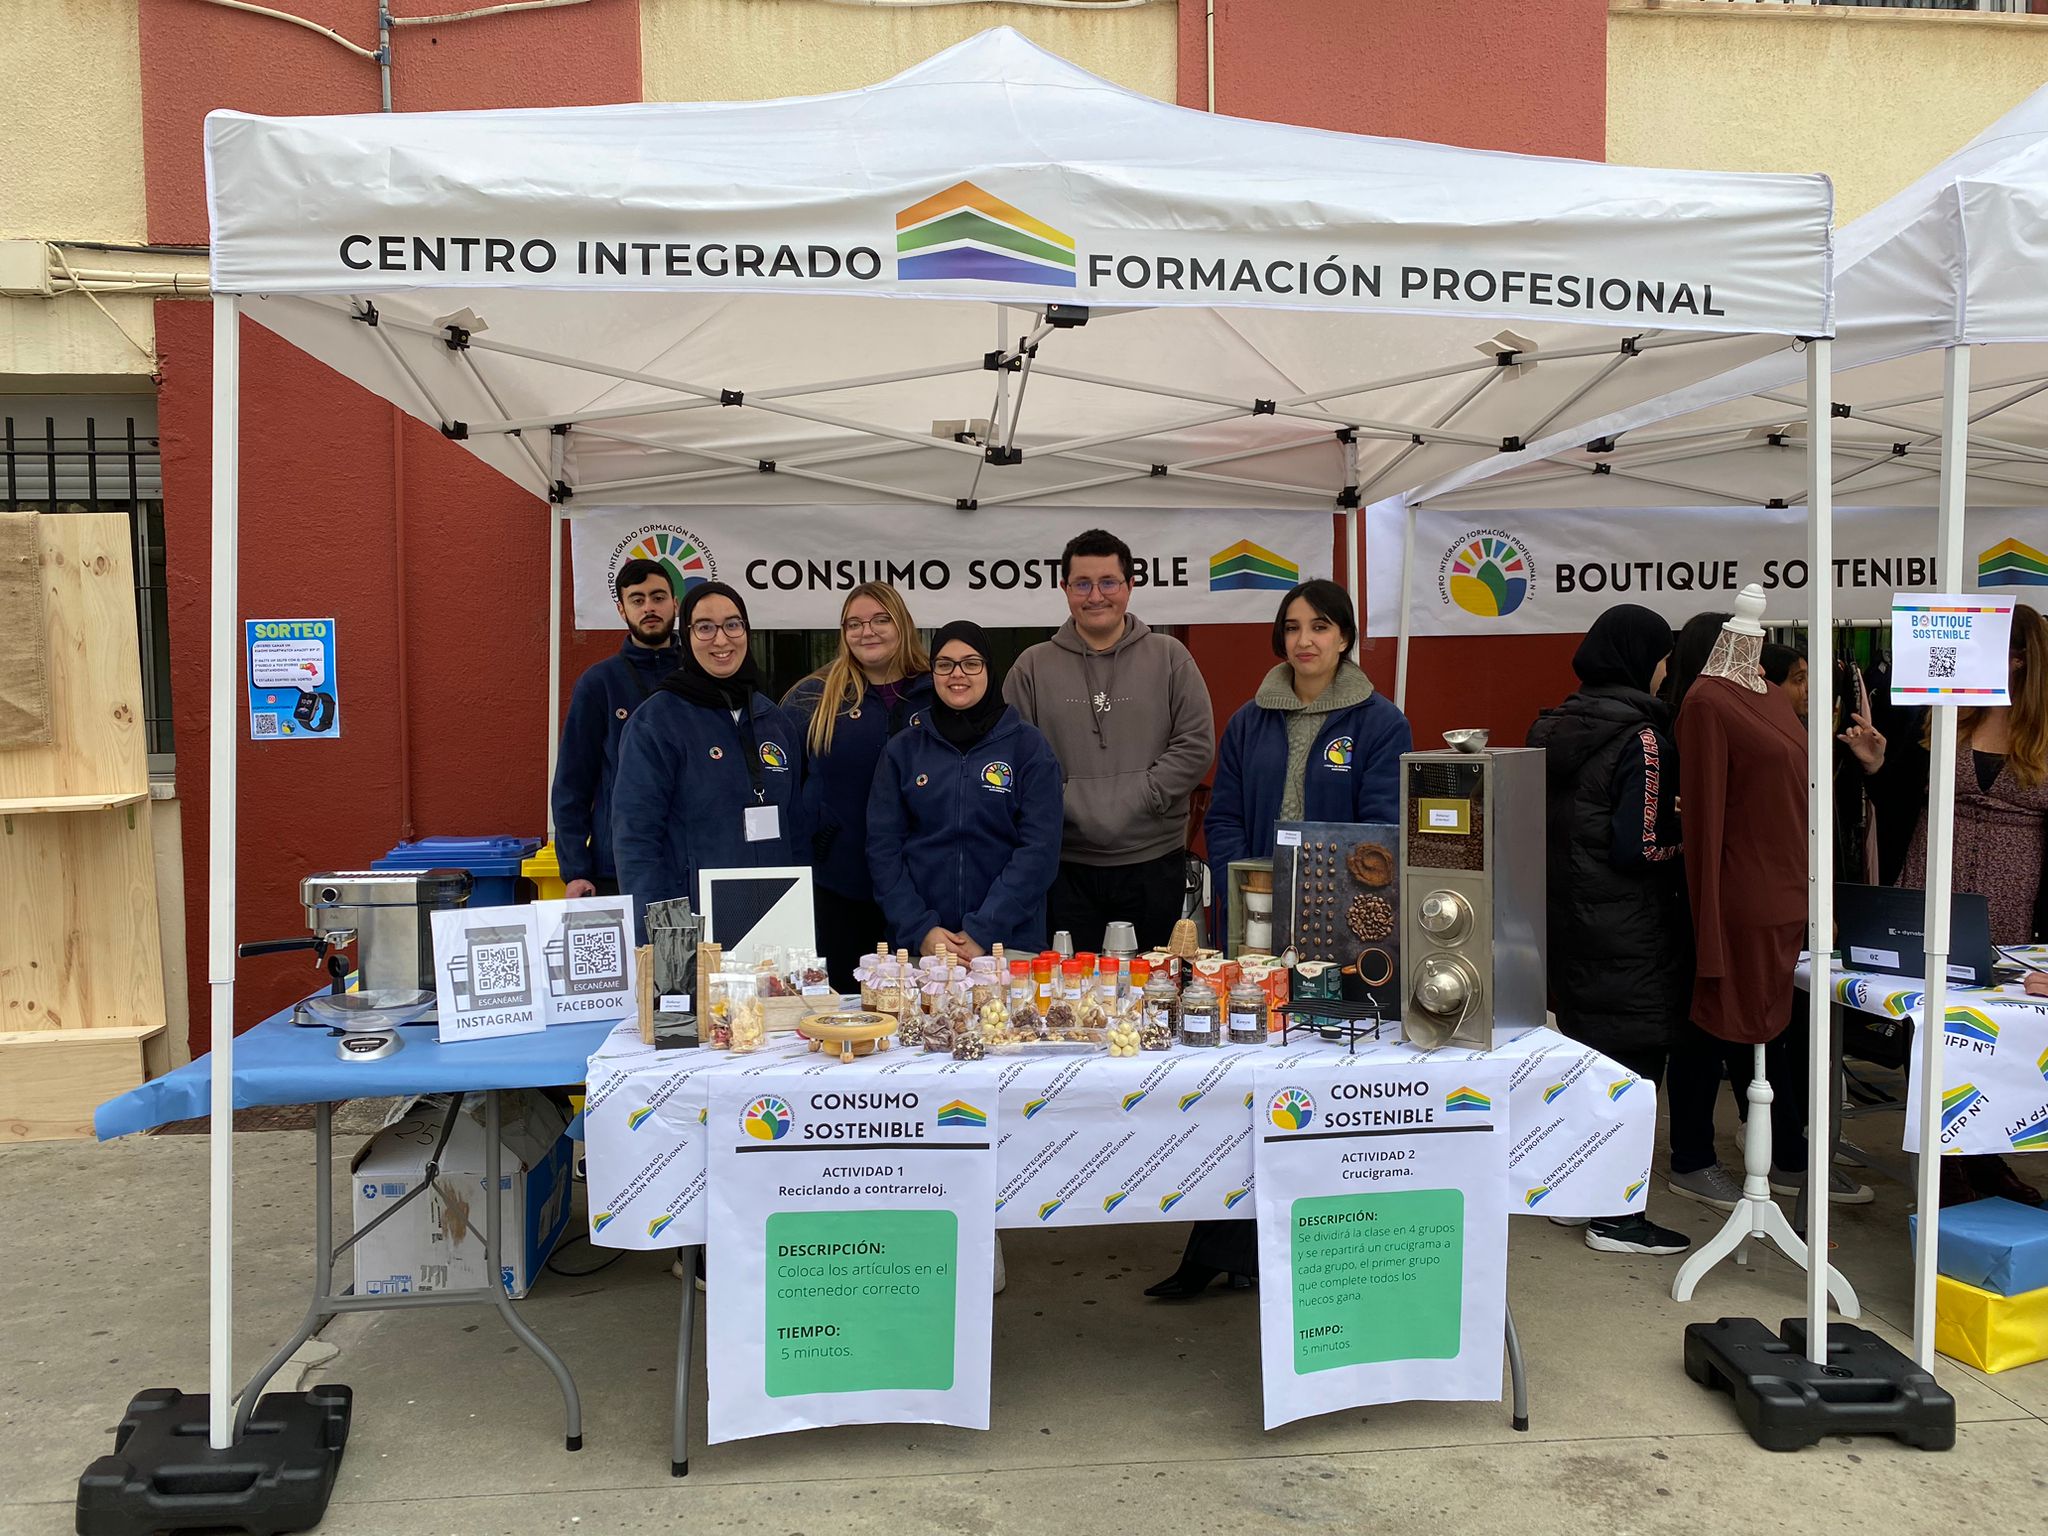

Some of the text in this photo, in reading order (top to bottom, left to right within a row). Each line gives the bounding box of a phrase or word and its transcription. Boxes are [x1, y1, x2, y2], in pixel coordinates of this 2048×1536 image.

[339, 235, 1725, 316] CENTRO INTEGRADO FORMACIÓN PROFESIONAL
[1466, 529, 1512, 540] FORMACIÓN
[608, 531, 638, 570] INTEGRADO
[639, 524, 689, 536] FORMACIÓN
[689, 533, 719, 582] PROFESIONAL
[1439, 536, 1466, 573] INTEGRADO
[1511, 537, 1537, 582] PROFESIONAL
[745, 556, 1189, 590] CONSUMO SOSTBLE
[1556, 557, 1938, 594] BOUTIQUE SOTENIBL
[1438, 575, 1450, 605] CENTRO
[255, 623, 327, 638] SORTEO
[1912, 629, 1970, 640] SOSTENIBLE
[573, 980, 620, 992] ESCANÉAME
[478, 994, 524, 1007] ESCANÉAME
[556, 996, 623, 1013] FACEBOOK
[456, 1011, 533, 1029] INSTAGRAM
[1944, 1034, 1969, 1048] IFP
[998, 1066, 1024, 1094] MACIÓN
[1139, 1066, 1162, 1090] CENTRO
[1144, 1060, 1178, 1096] FORMACIÓN
[1196, 1067, 1220, 1091] CENTRO
[1202, 1059, 1236, 1096] FORMACIÓN
[1513, 1054, 1545, 1088] FORMACIÓN
[1560, 1059, 1584, 1082] CENTRO
[1566, 1054, 1598, 1088] FORMACIÓN
[591, 1073, 628, 1112] FORMACIÓN
[646, 1080, 672, 1105] CENTRO
[652, 1073, 690, 1112] FORMACIÓN
[1040, 1072, 1065, 1098] CENTRO
[1046, 1066, 1081, 1103] FORMACIÓN
[1330, 1081, 1429, 1100] CONSUMO
[810, 1092, 919, 1111] CONSUMO
[1324, 1107, 1434, 1128] SOSTENIBLE
[1941, 1115, 1968, 1144] CIFP
[803, 1121, 924, 1140] SOSTENIBLE
[1525, 1117, 1565, 1156] PROFESIONAL
[1003, 1166, 1040, 1204] FORMACIÓN
[1036, 1129, 1079, 1171] PROFESIONAL
[1061, 1130, 1136, 1204] FORMACIÓN PROFESIONAL
[1120, 1133, 1178, 1192] CENTRO INTEGRADO
[1125, 1122, 1200, 1196] FORMACIÓN PROFESIONAL
[1177, 1134, 1234, 1192] CENTRO INTEGRADO
[1341, 1150, 1416, 1163] ACTIVIDAD 2
[1543, 1131, 1601, 1186] CENTRO INTEGRADO
[1549, 1121, 1625, 1192] FORMACIÓN PROFESIONAL
[606, 1152, 664, 1211] CENTRO INTEGRADO
[612, 1139, 689, 1219] FORMACIÓN PROFESIONAL
[822, 1166, 904, 1178] ACTIVIDAD 1
[998, 1174, 1023, 1199] CENTRO
[1022, 1140, 1056, 1179] INTEGRADO
[1056, 1141, 1113, 1199] CENTRO INTEGRADO
[1182, 1160, 1217, 1197] FORMACIÓN
[1342, 1167, 1414, 1180] Crucigrama.
[665, 1188, 690, 1214] CENTRO
[779, 1182, 947, 1198] Reciclando a contrarreloj.
[1299, 1210, 1378, 1227] DESCRIPCIÓN:
[1298, 1223, 1455, 1243] Se dividirá la clase en 4 grupos
[778, 1240, 885, 1258] DESCRIPCIÓN:
[1297, 1239, 1451, 1262] y se repartirá un crucigrama a
[777, 1261, 948, 1278] Coloca los artículos en el
[1298, 1255, 1440, 1275] cada grupo, el primer grupo
[777, 1283, 920, 1299] contenedor correcto
[1298, 1271, 1417, 1292] que complete todos los
[777, 1325, 841, 1340] TIEMPO:
[1299, 1325, 1343, 1340] TIEMPO:
[781, 1345, 854, 1360] 5 minutos.
[1302, 1346, 1308, 1356] 5
